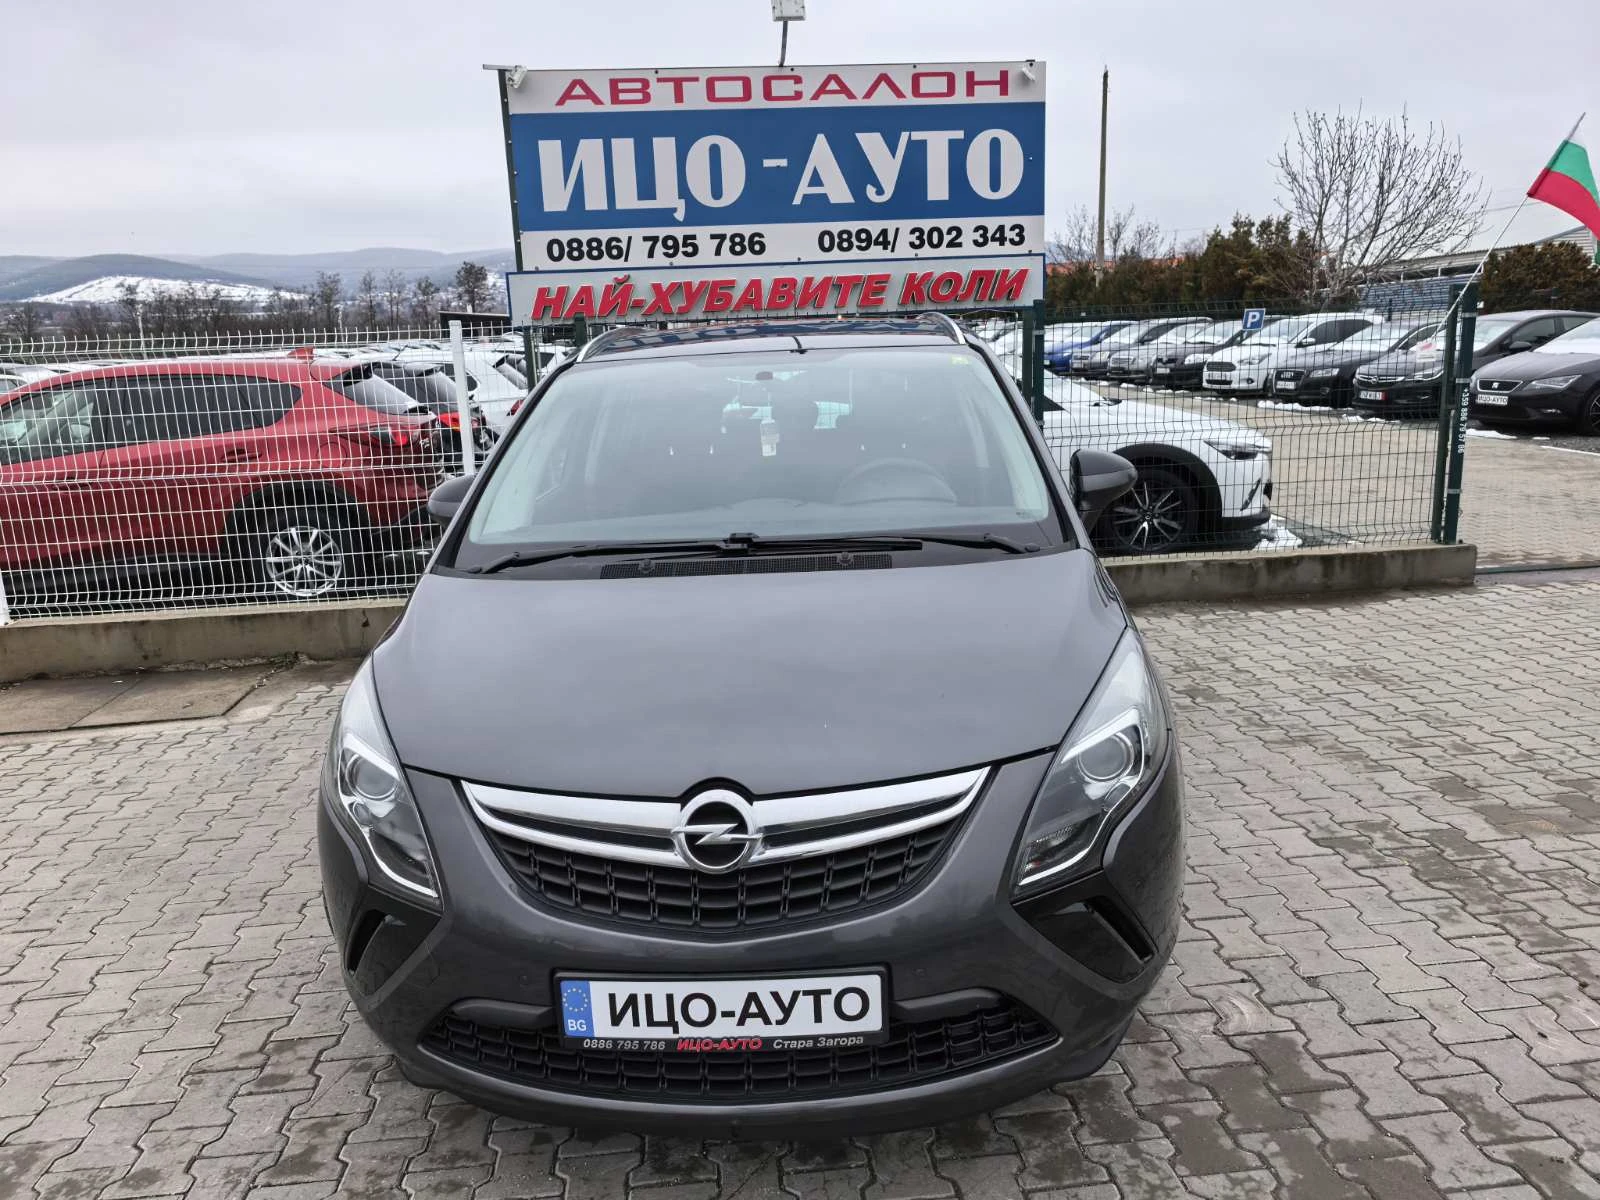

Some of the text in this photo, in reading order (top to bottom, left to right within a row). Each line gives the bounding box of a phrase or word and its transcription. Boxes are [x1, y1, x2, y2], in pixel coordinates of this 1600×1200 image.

[555, 70, 1009, 106] АВТОСАЛОН
[546, 231, 767, 262] 0886/ 795 786
[817, 223, 1026, 252] 0894/ 302 343
[531, 267, 1030, 319] НАЙ-ХУБАВИТЕ КОЛИ
[1247, 311, 1260, 328] P
[608, 987, 870, 1034] ИЦО-АУТО
[567, 1019, 587, 1031] BG
[583, 1039, 666, 1050] 0886 795 786
[676, 1036, 763, 1052] ИЦО-АУТО
[773, 1036, 864, 1050] Стара Загора
